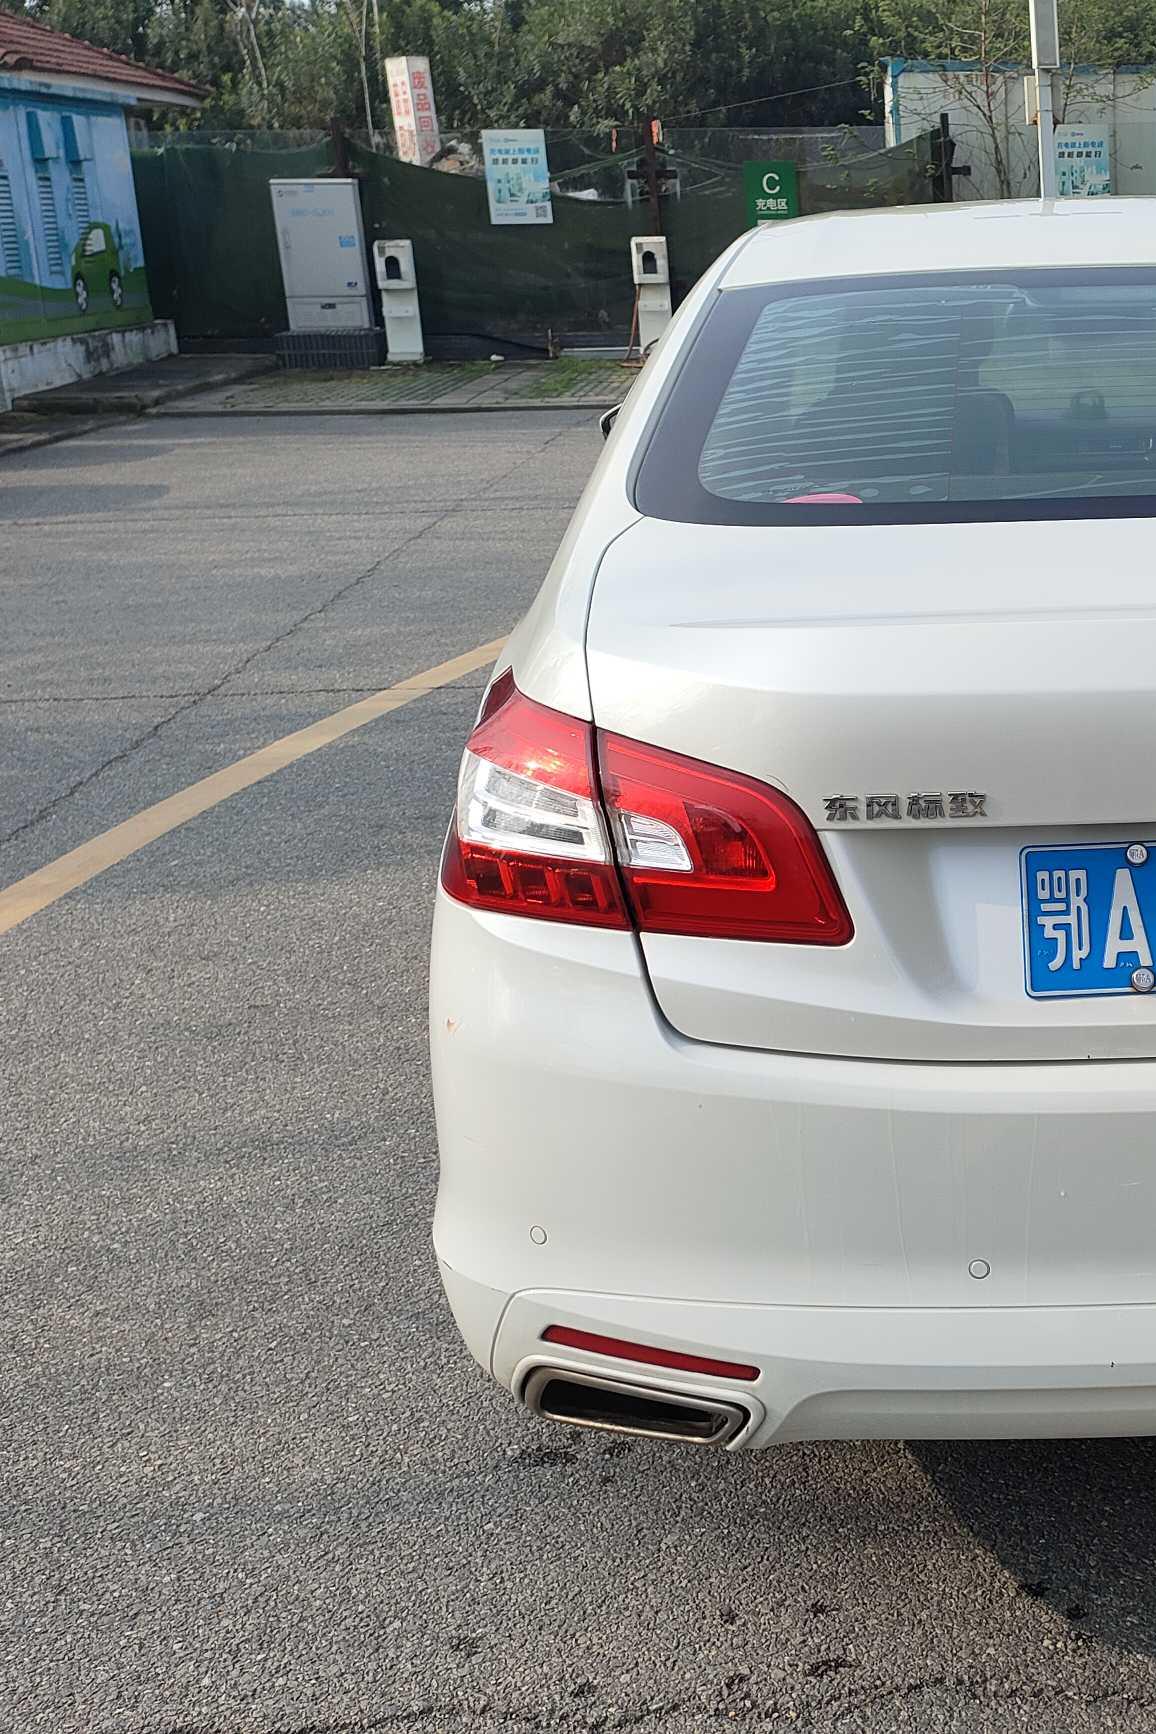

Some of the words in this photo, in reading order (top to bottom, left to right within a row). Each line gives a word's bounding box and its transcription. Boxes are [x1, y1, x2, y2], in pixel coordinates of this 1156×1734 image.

[762, 172, 780, 194] C
[755, 198, 788, 210] 充电区
[822, 791, 988, 821] 东风标致
